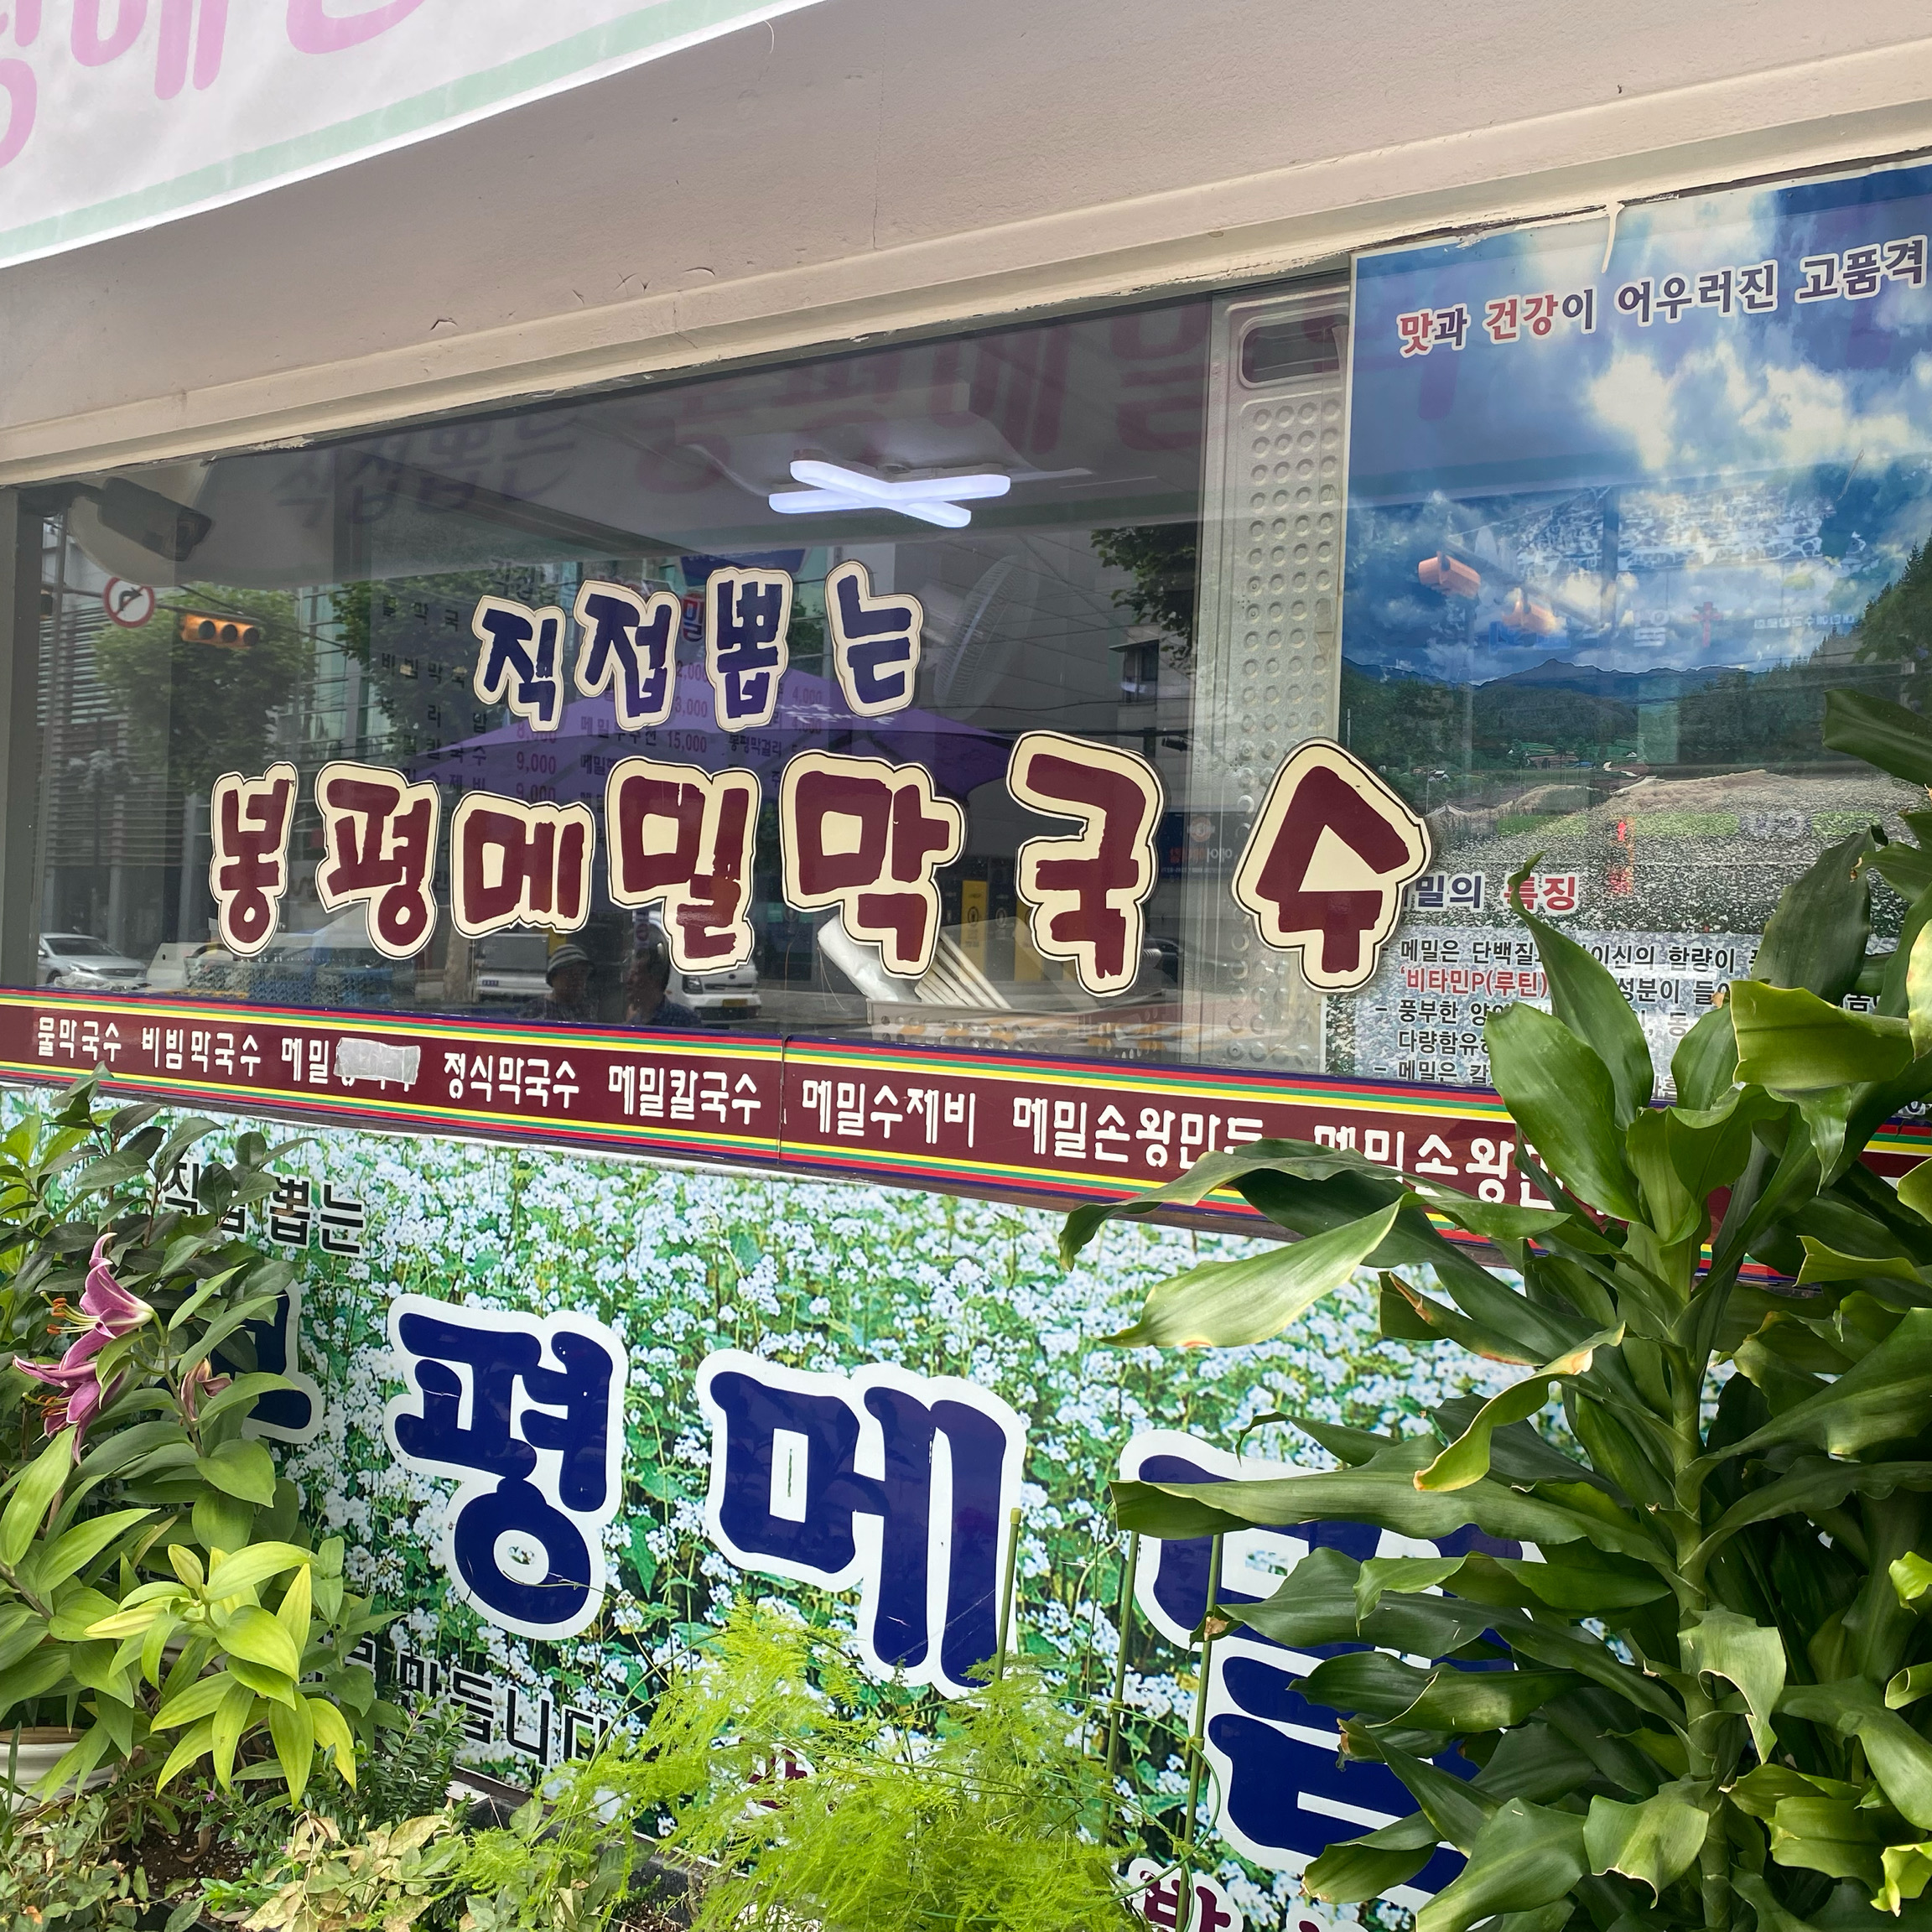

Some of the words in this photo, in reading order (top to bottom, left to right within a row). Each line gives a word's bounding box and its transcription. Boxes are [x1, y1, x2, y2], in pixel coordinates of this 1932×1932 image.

[1400, 309, 1467, 353] 맛과
[1486, 289, 1593, 340] 건강이
[1618, 264, 1774, 322] 어우러진
[1798, 240, 1923, 300] 고품격
[482, 574, 913, 722] 직접뽑는
[667, 730, 708, 753] 15,000
[516, 750, 557, 776] 9,000
[220, 753, 1410, 979] 봉평메밀막국수
[1404, 875, 1482, 909] 밀의
[1504, 875, 1576, 911] 특징
[1400, 938, 1460, 963] 메밀은
[1472, 941, 1542, 966] 단백질
[1669, 946, 1736, 974] 함량이
[1398, 999, 1459, 1025] 풍부한
[1398, 1029, 1489, 1057] 다량함유
[37, 1015, 122, 1062] 물막국수
[141, 1026, 262, 1078] 비빔막국수
[443, 1051, 579, 1109] 정식막국수
[608, 1064, 762, 1125] 메밀칼국수
[802, 1078, 976, 1148] 메밀수제비
